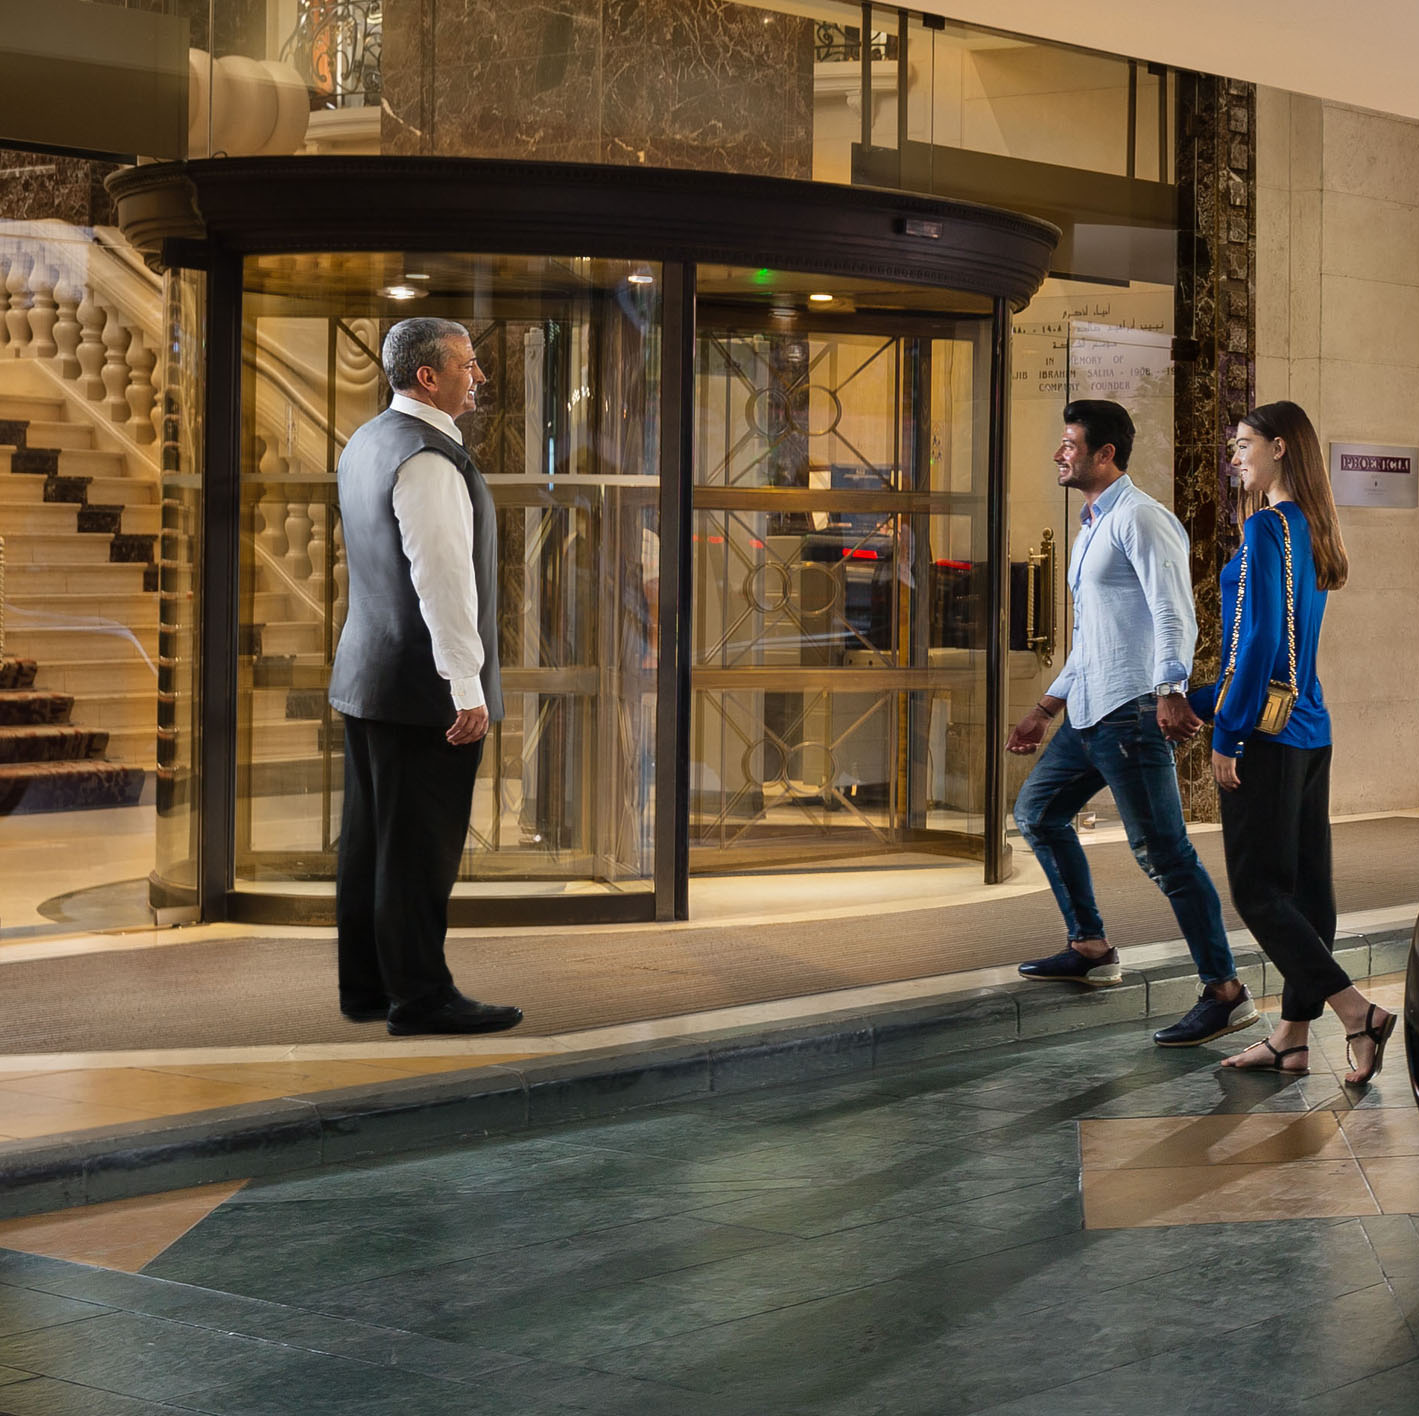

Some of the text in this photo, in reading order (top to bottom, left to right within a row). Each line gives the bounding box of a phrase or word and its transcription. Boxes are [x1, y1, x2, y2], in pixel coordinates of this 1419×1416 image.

[1045, 357, 1055, 366] IN
[1113, 355, 1124, 364] OF
[1039, 369, 1076, 380] IBRAHM
[1343, 456, 1409, 472] PHOENICIA
